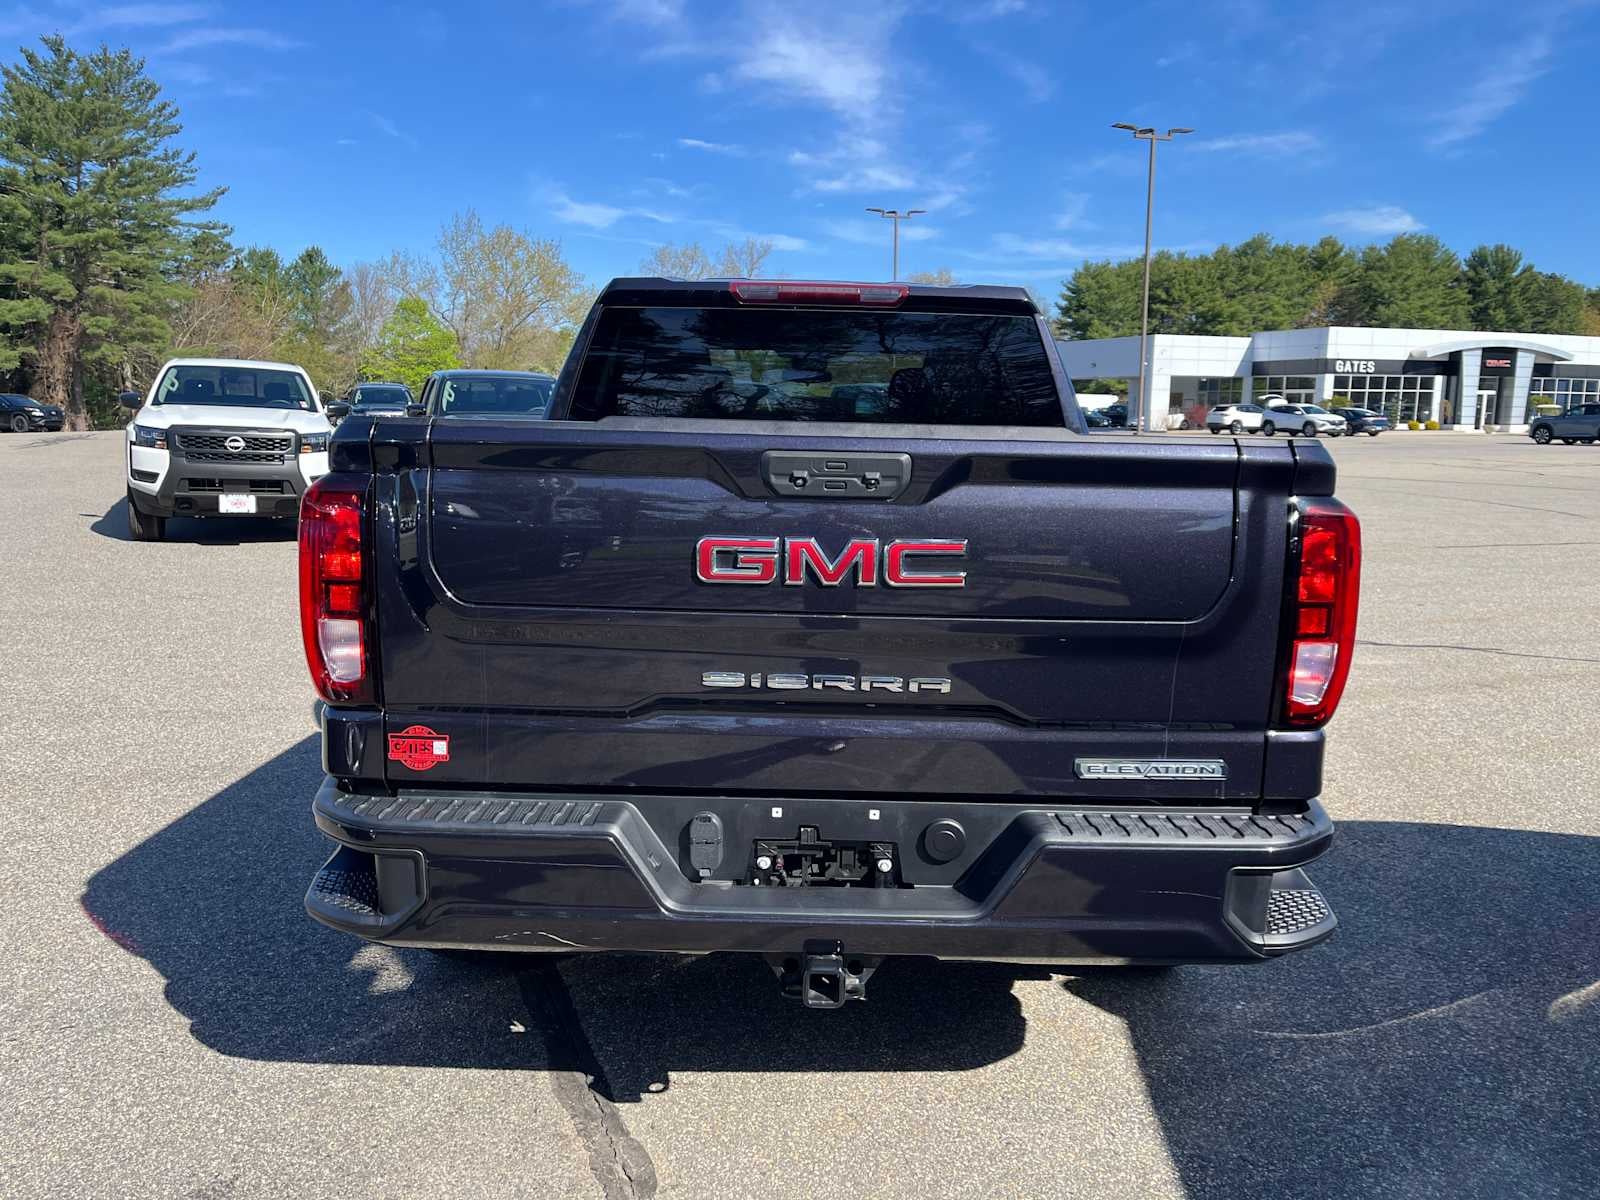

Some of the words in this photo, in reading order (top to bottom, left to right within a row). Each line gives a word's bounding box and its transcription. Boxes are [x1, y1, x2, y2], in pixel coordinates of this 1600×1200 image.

[1335, 360, 1376, 373] GATES
[696, 535, 968, 587] GMC
[702, 671, 952, 693] SIERRA
[1087, 763, 1217, 775] ELEVATION
